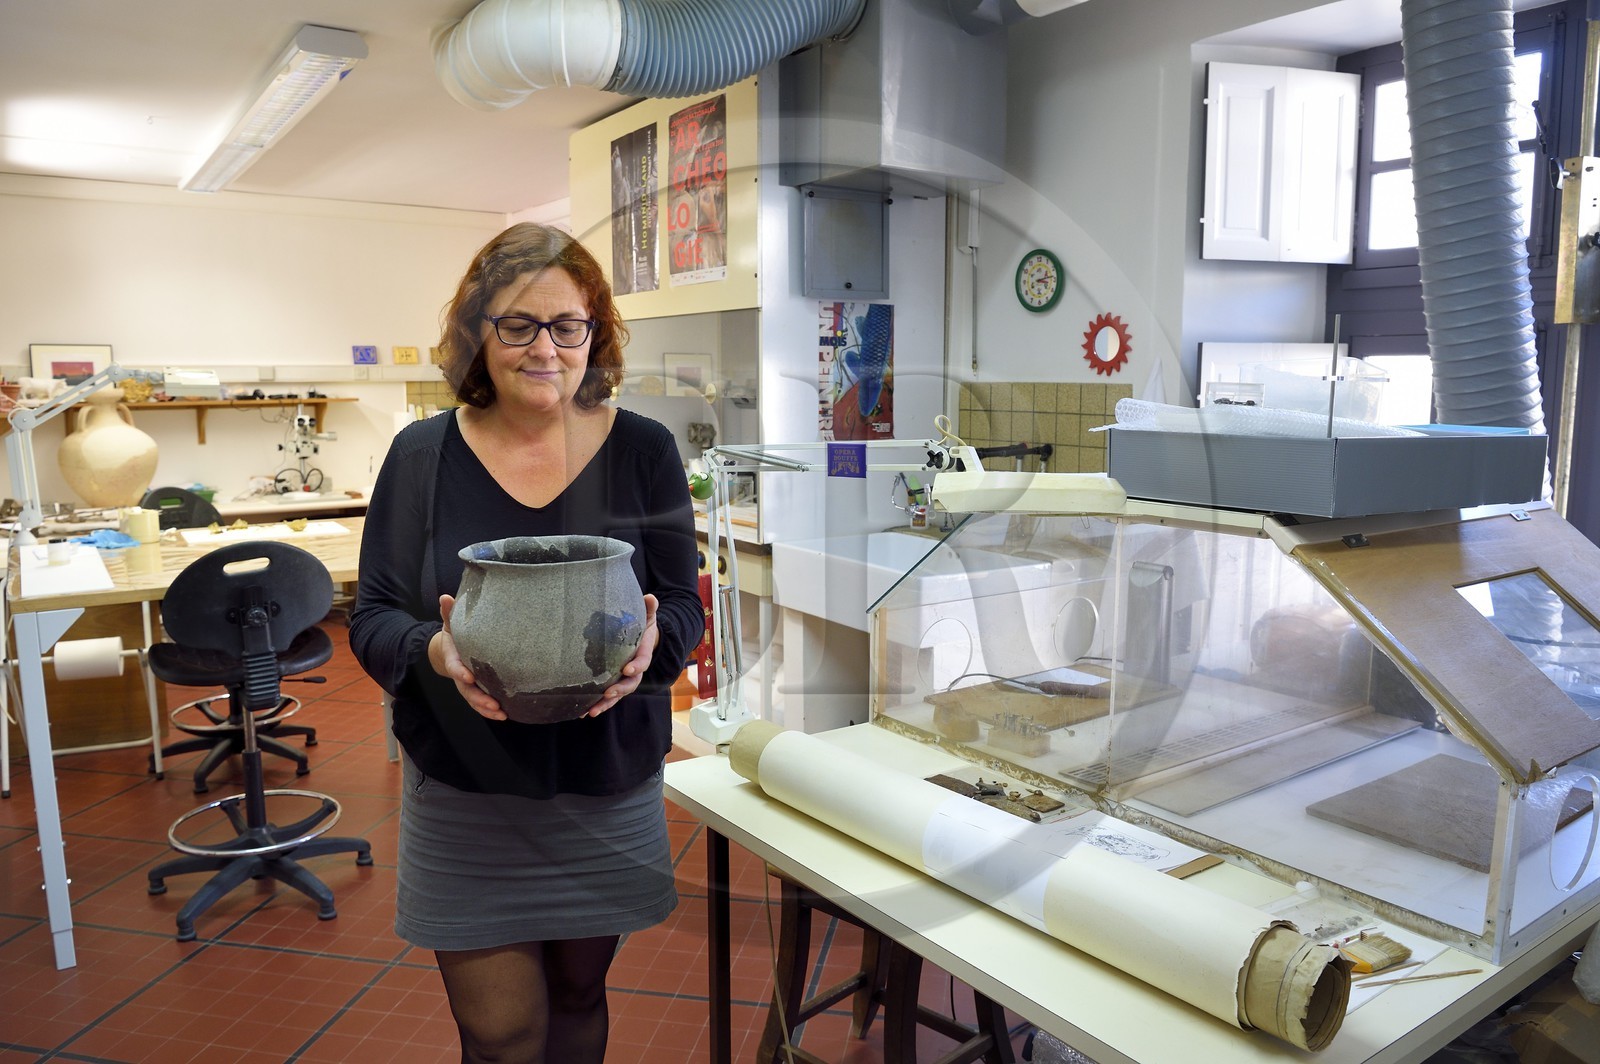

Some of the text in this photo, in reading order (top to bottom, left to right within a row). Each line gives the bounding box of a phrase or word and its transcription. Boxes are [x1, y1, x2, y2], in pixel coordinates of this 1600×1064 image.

[674, 121, 700, 154] AR
[673, 152, 727, 191] CHÉO
[667, 202, 690, 231] LO
[675, 237, 703, 267] GIE
[819, 302, 834, 337] UN
[819, 331, 848, 346] MOIS
